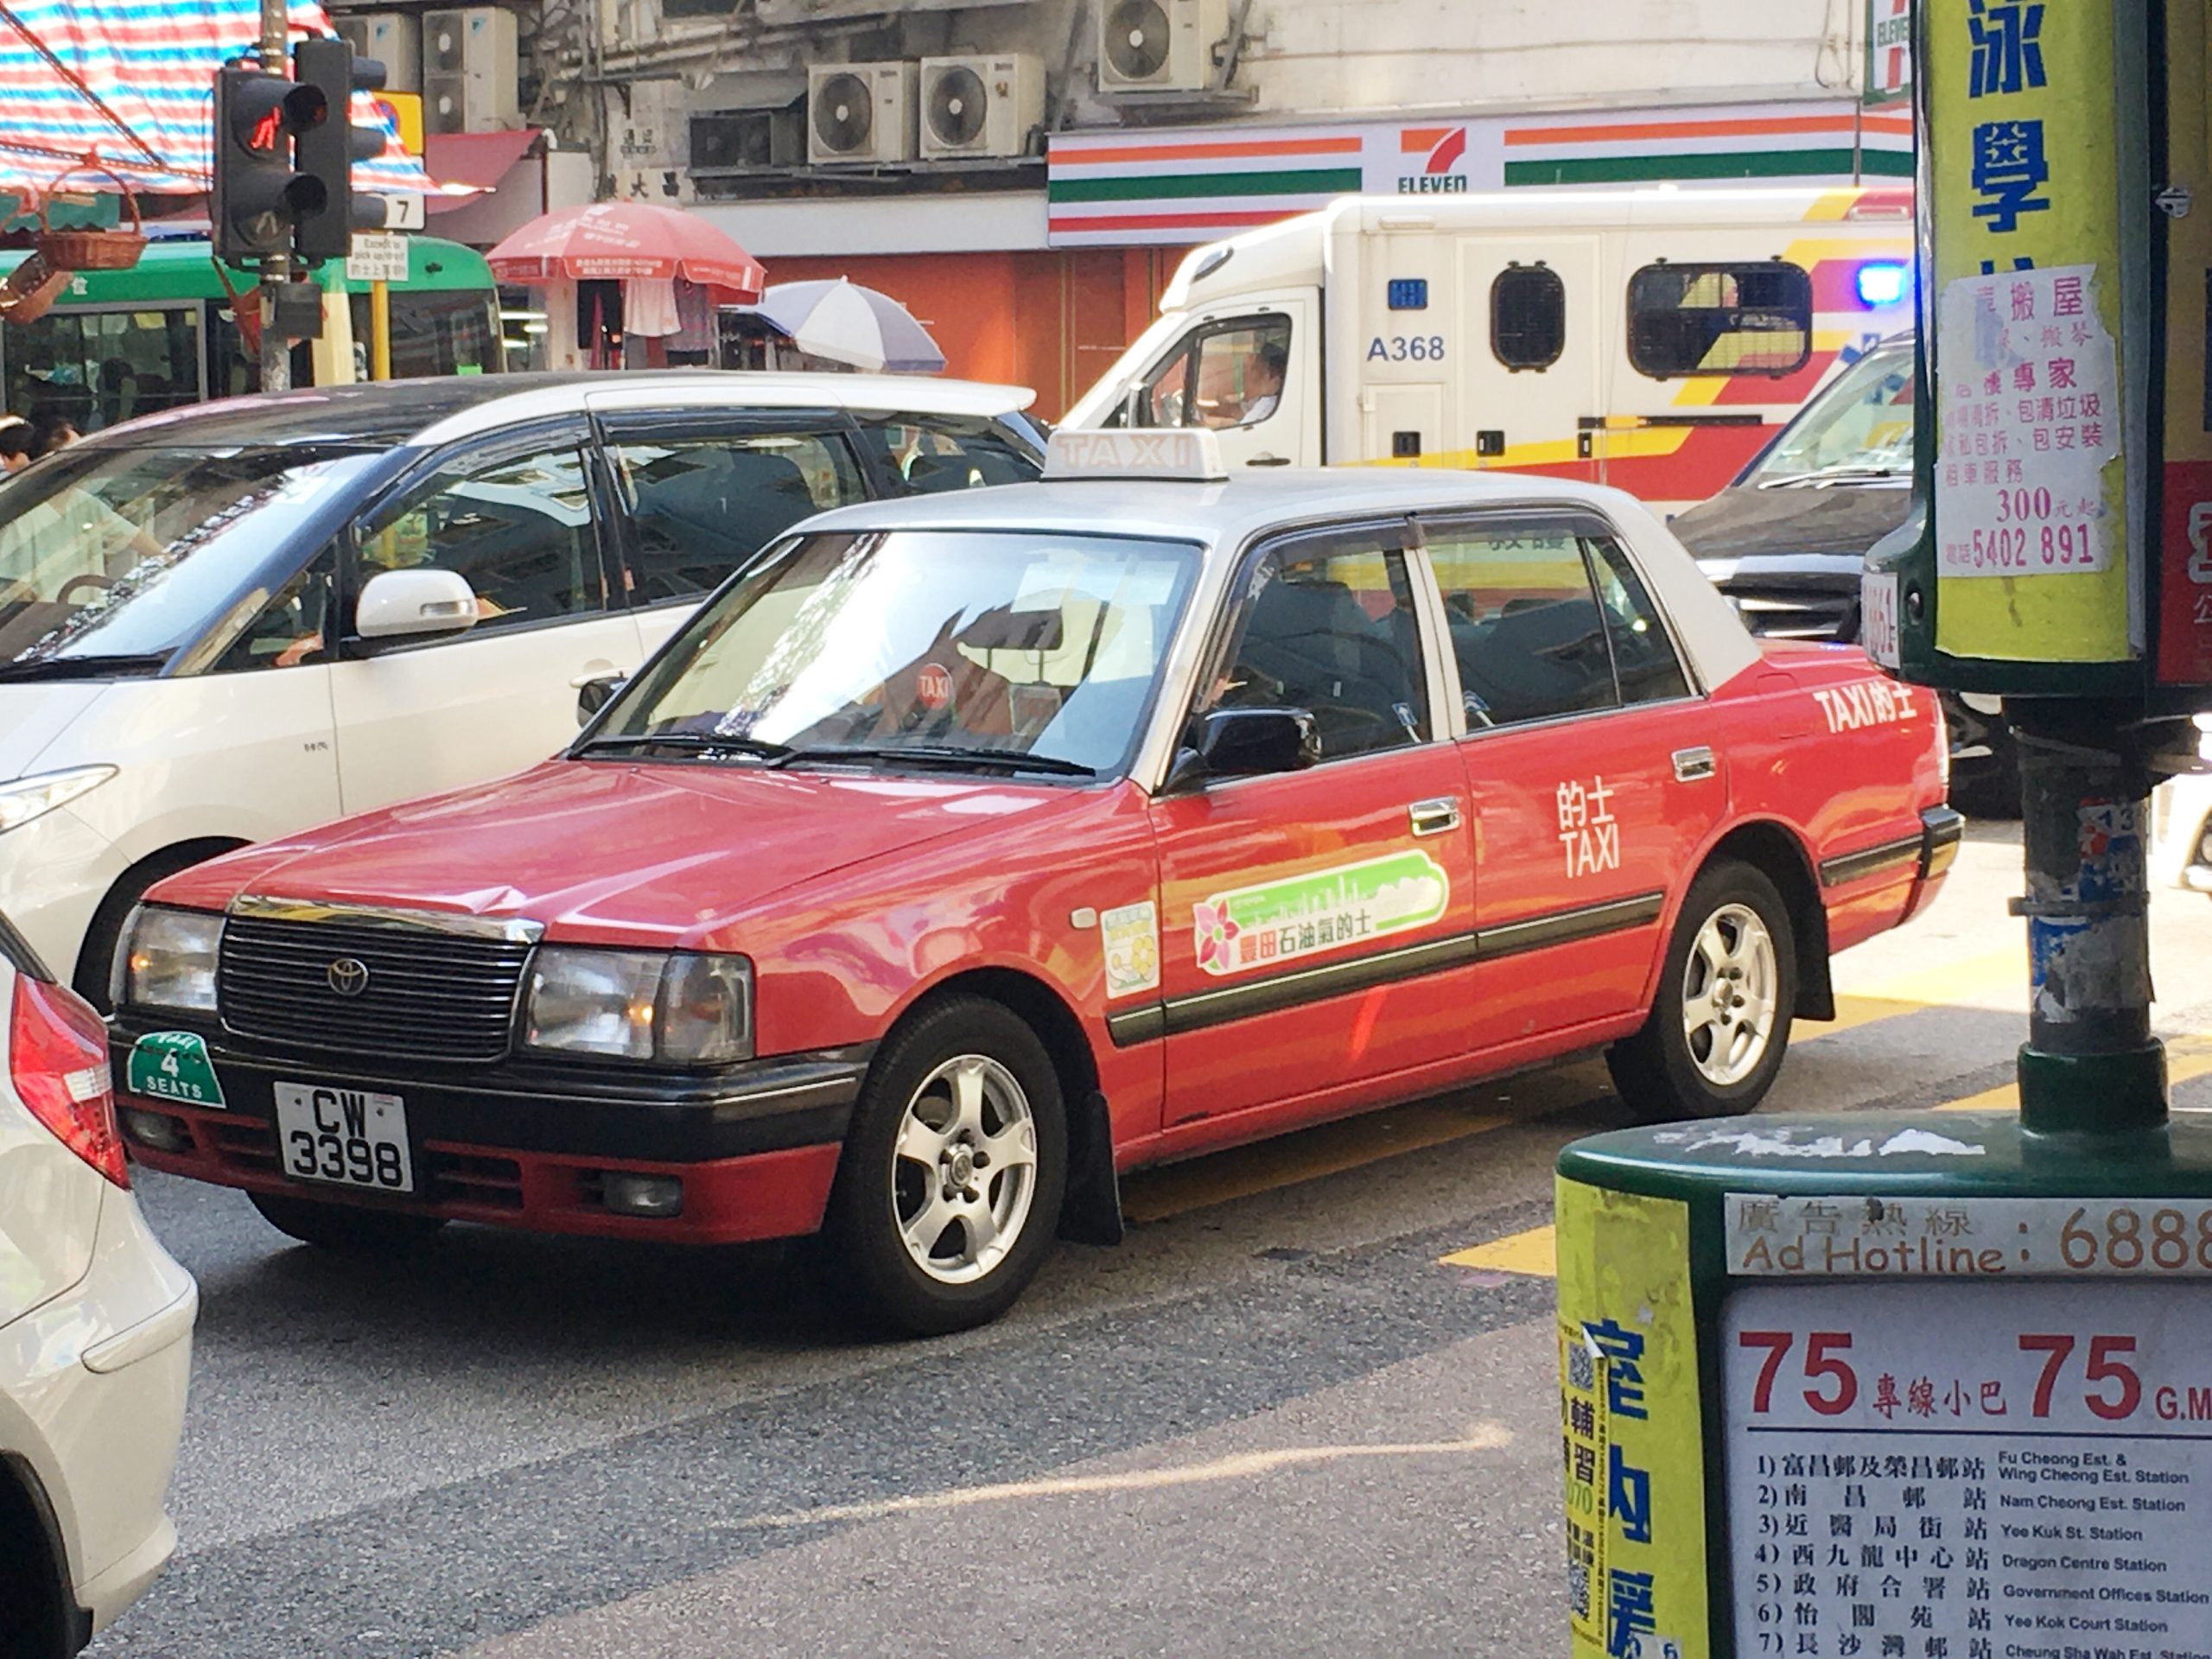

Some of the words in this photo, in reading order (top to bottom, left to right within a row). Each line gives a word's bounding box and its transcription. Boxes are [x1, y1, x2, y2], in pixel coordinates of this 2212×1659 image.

[1401, 127, 1465, 174] 7
[1967, 0, 2050, 275] 泳學
[1367, 336, 1445, 361] A368
[1056, 435, 1191, 469] TAXI
[1556, 774, 1614, 830] 的士
[1559, 822, 1619, 879] TAXI
[1239, 908, 1371, 964] 豐田石油氣的士
[161, 1047, 179, 1077] 4
[146, 1075, 202, 1099] SEATS
[312, 1090, 365, 1138] CW
[290, 1131, 403, 1187] 3398
[1742, 1236, 1804, 1271] Ad
[1738, 1331, 1859, 1416] 75
[1872, 1372, 2007, 1420] 專線小巴
[2018, 1334, 2143, 1421] 75
[1999, 1451, 2017, 1465] Fu
[2021, 1452, 2079, 1468] Cheong
[2116, 1453, 2126, 1465] &
[1999, 1467, 2037, 1483] Wing
[2040, 1468, 2099, 1484] Cheong
[2135, 1470, 2190, 1484] Station
[2000, 1495, 2034, 1508] Nam
[2037, 1496, 2095, 1511] Cheong
[2133, 1497, 2186, 1511] Station
[2000, 1523, 2029, 1538] Yee
[2032, 1525, 2063, 1539] Kuk
[2089, 1527, 2143, 1541] Station
[2002, 1554, 2056, 1571] Dragon
[2060, 1556, 2110, 1570] Centre
[2114, 1558, 2167, 1572] Station
[2003, 1585, 2094, 1599] Government
[2099, 1587, 2152, 1601] Offices
[2156, 1589, 2209, 1604] Station
[2005, 1614, 2031, 1628] Yee
[2036, 1616, 2065, 1630] Kok
[2069, 1617, 2110, 1631] Court
[2114, 1618, 2168, 1632] Station
